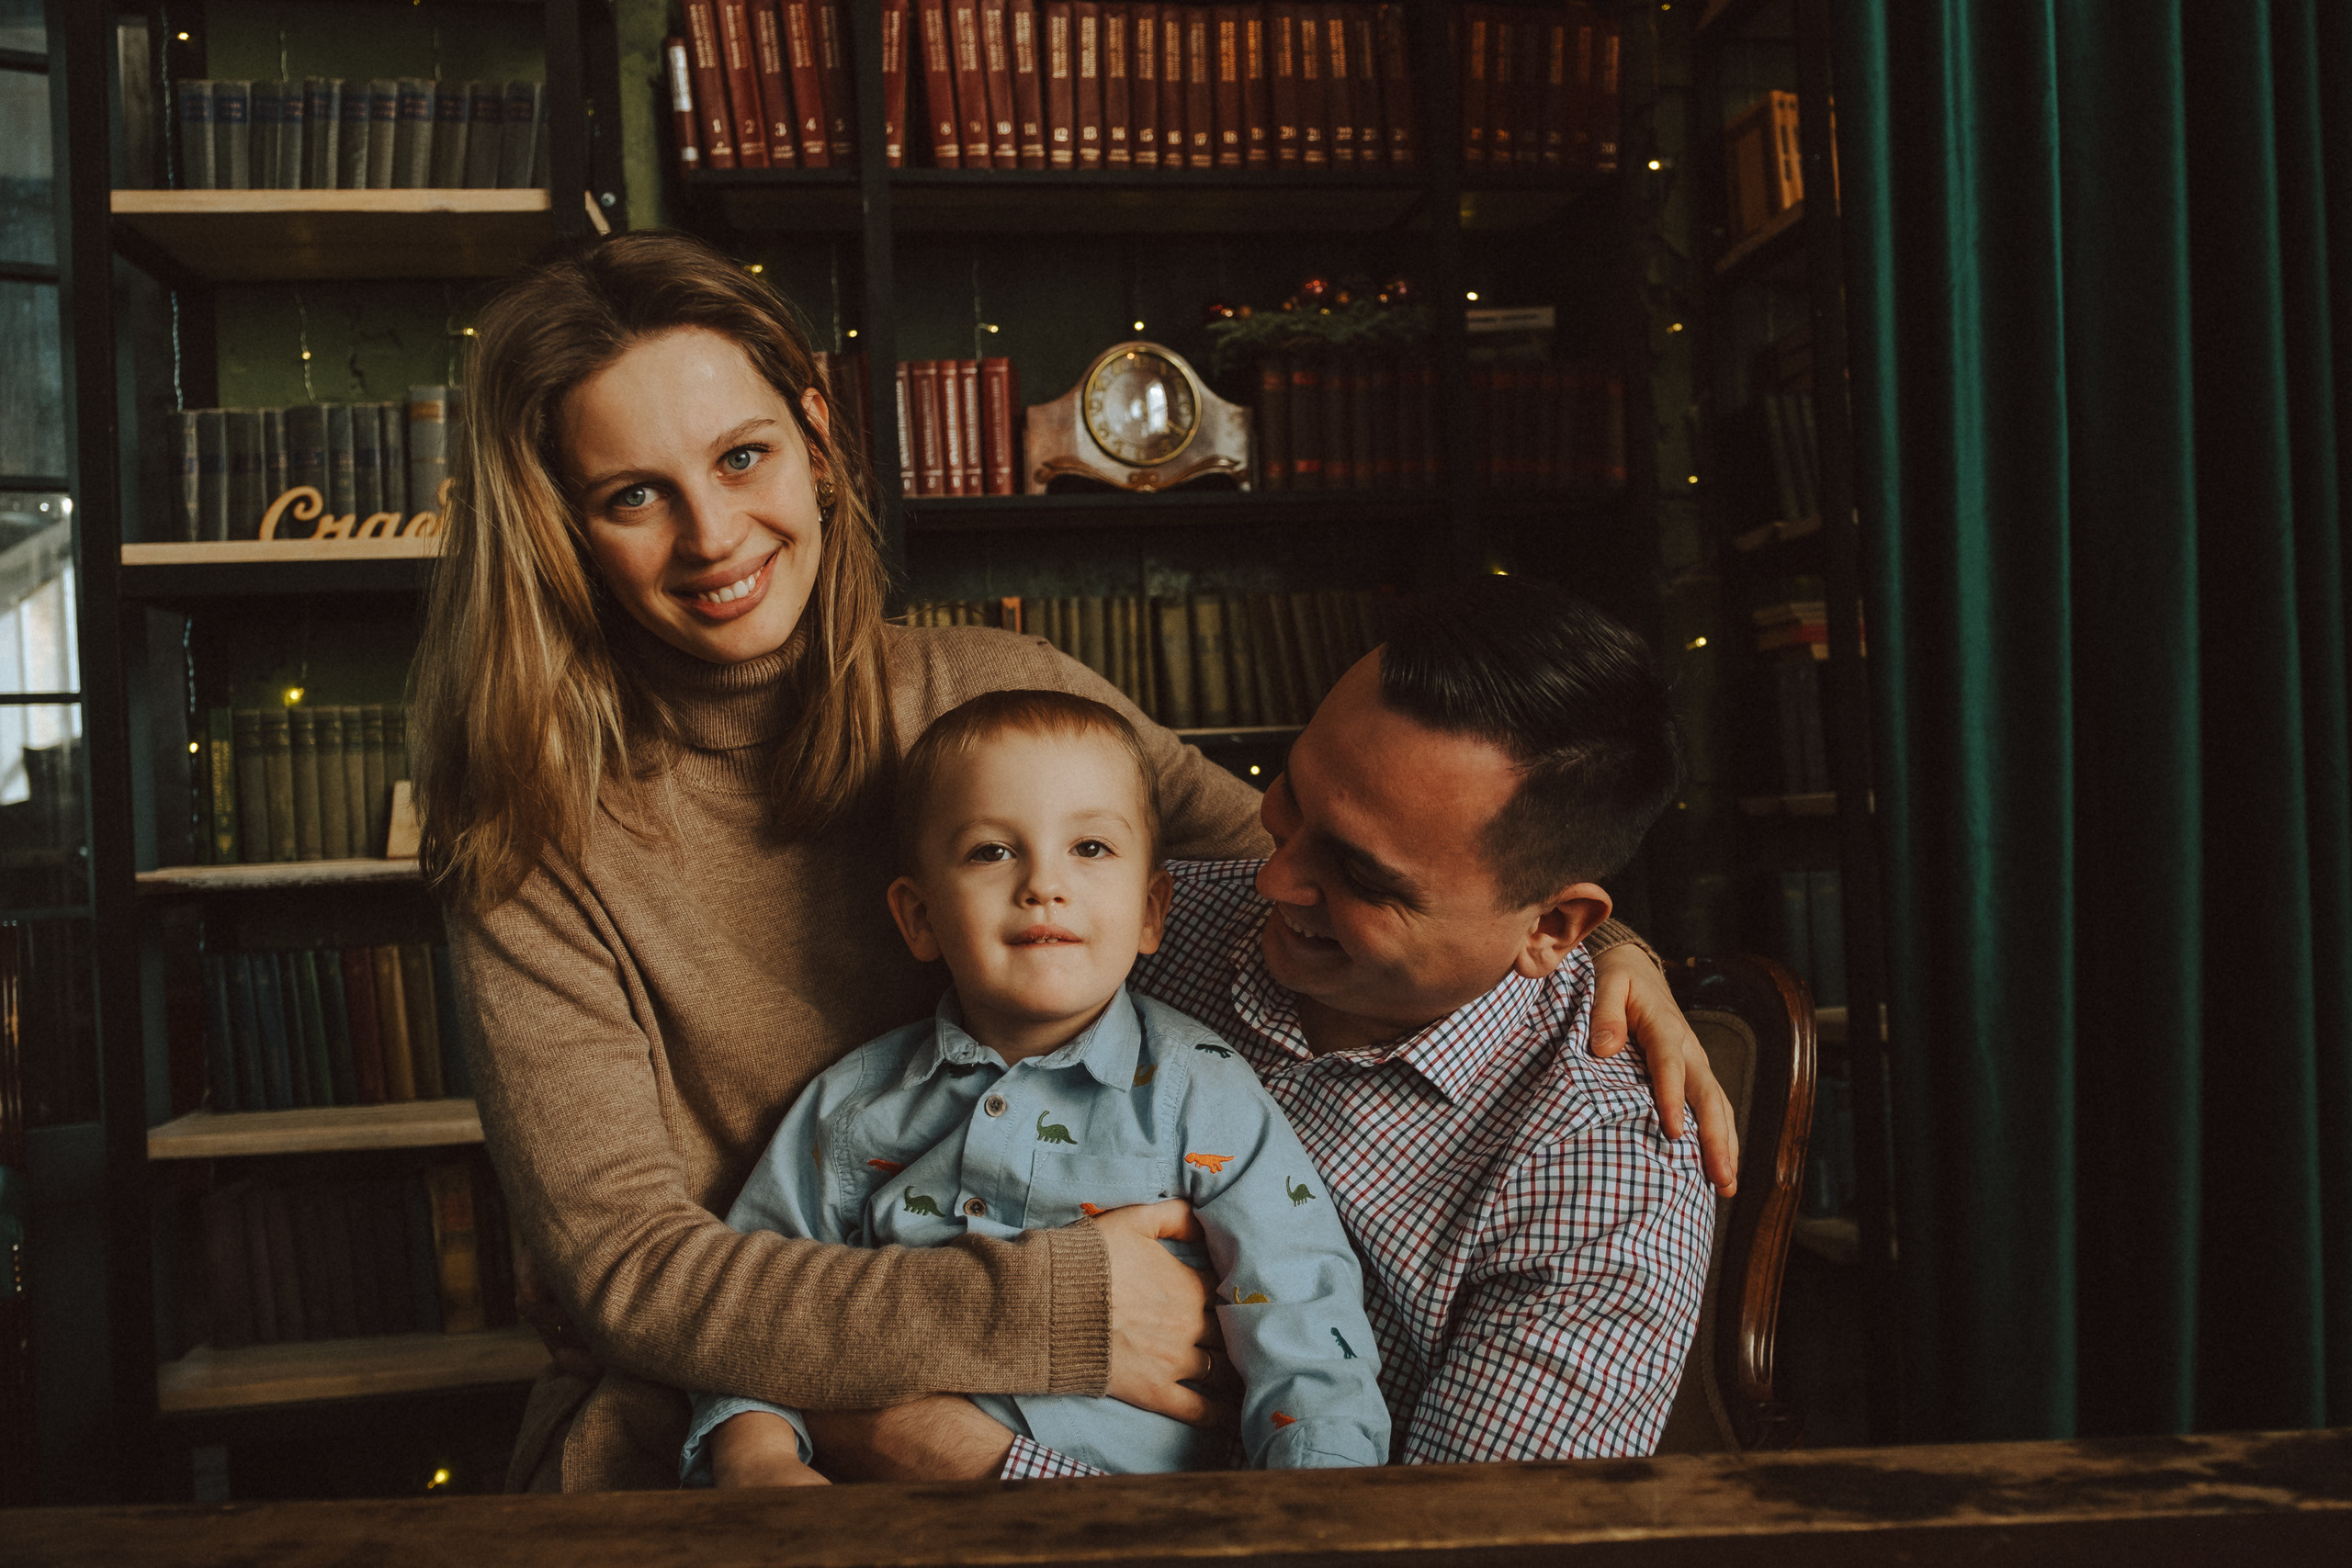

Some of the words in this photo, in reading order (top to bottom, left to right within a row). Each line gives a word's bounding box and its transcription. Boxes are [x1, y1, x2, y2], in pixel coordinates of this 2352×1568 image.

[712, 118, 721, 133] 1
[745, 118, 756, 134] 2
[775, 122, 787, 137] 3
[805, 117, 817, 132] 4
[997, 120, 1012, 135] 10
[1054, 127, 1069, 142] 12
[1139, 128, 1154, 142] 15
